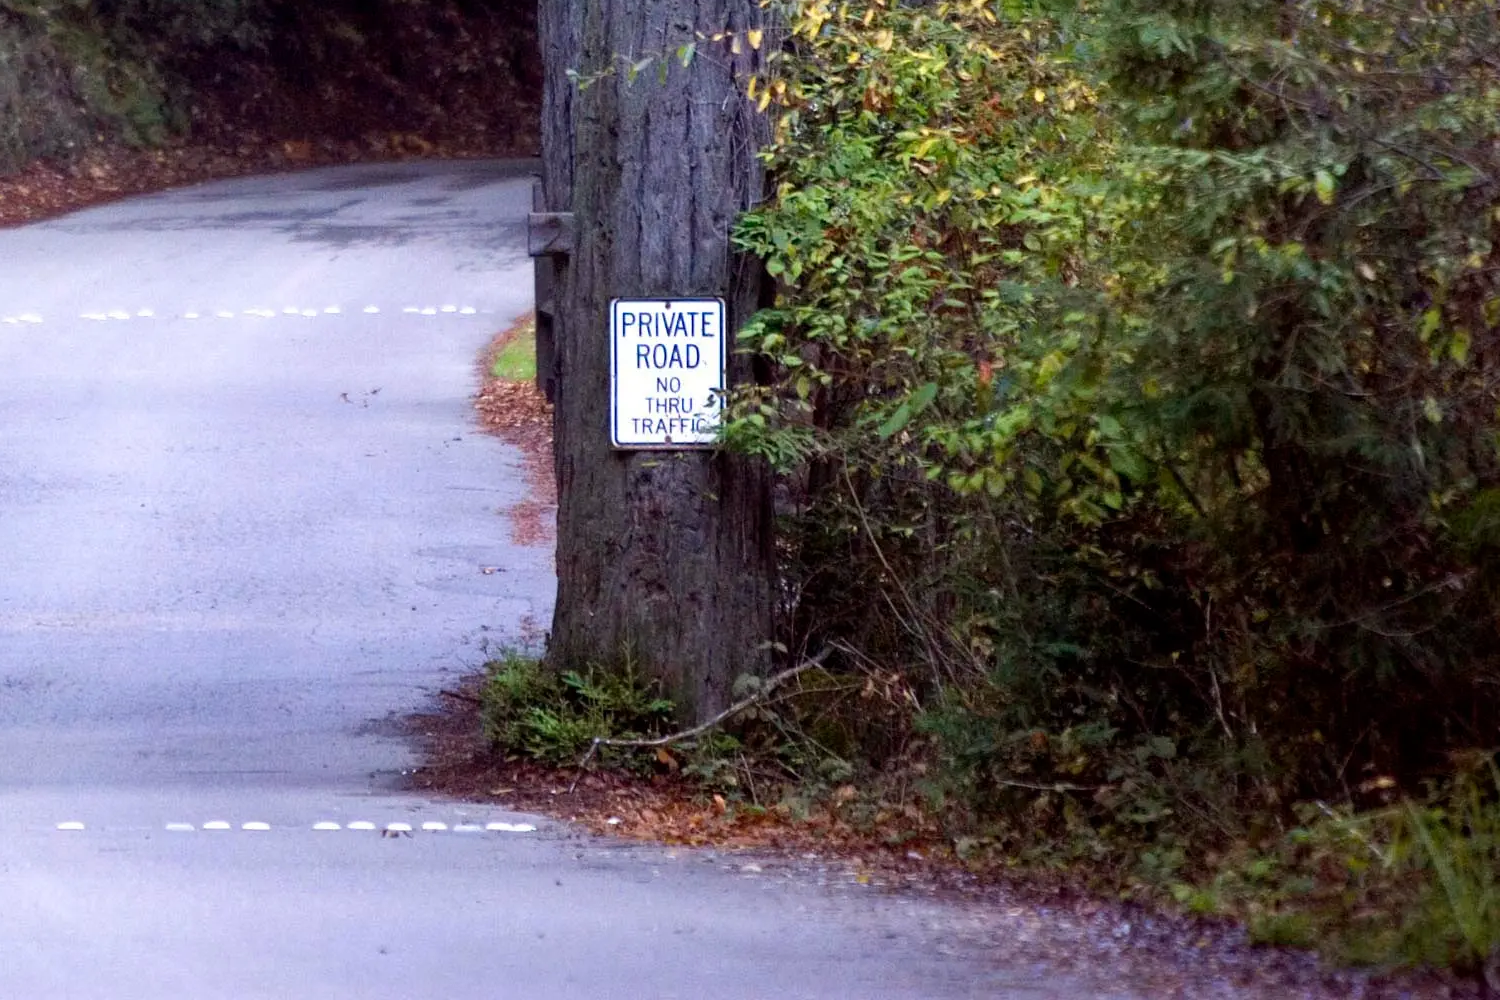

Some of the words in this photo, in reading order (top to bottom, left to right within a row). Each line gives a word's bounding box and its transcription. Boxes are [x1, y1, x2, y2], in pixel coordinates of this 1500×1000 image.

[622, 311, 715, 338] PRIVATE
[636, 343, 700, 369] ROAD
[656, 376, 681, 394] NO
[645, 397, 693, 414] THRU
